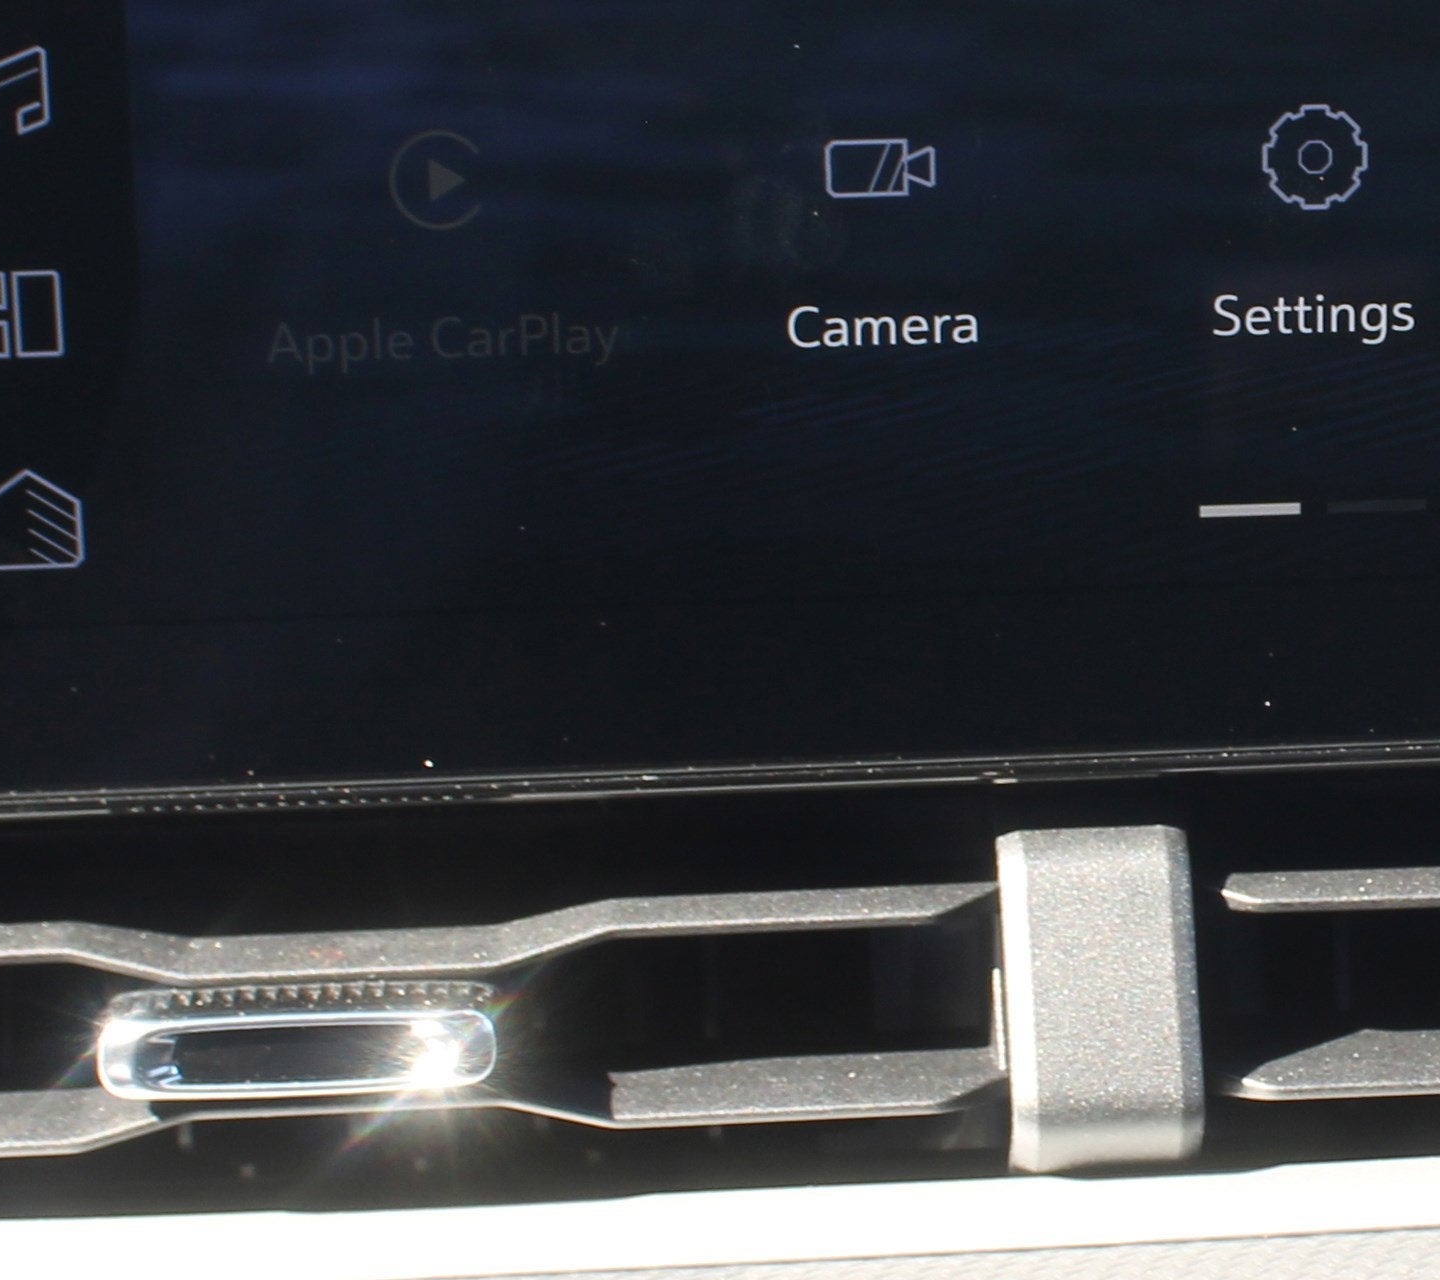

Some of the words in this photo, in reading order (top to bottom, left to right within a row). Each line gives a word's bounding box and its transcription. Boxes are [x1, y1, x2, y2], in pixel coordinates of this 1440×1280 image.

[267, 318, 415, 375] Apple
[430, 312, 621, 366] CarPlay
[786, 304, 980, 350] Camera
[1212, 292, 1416, 347] Settings
